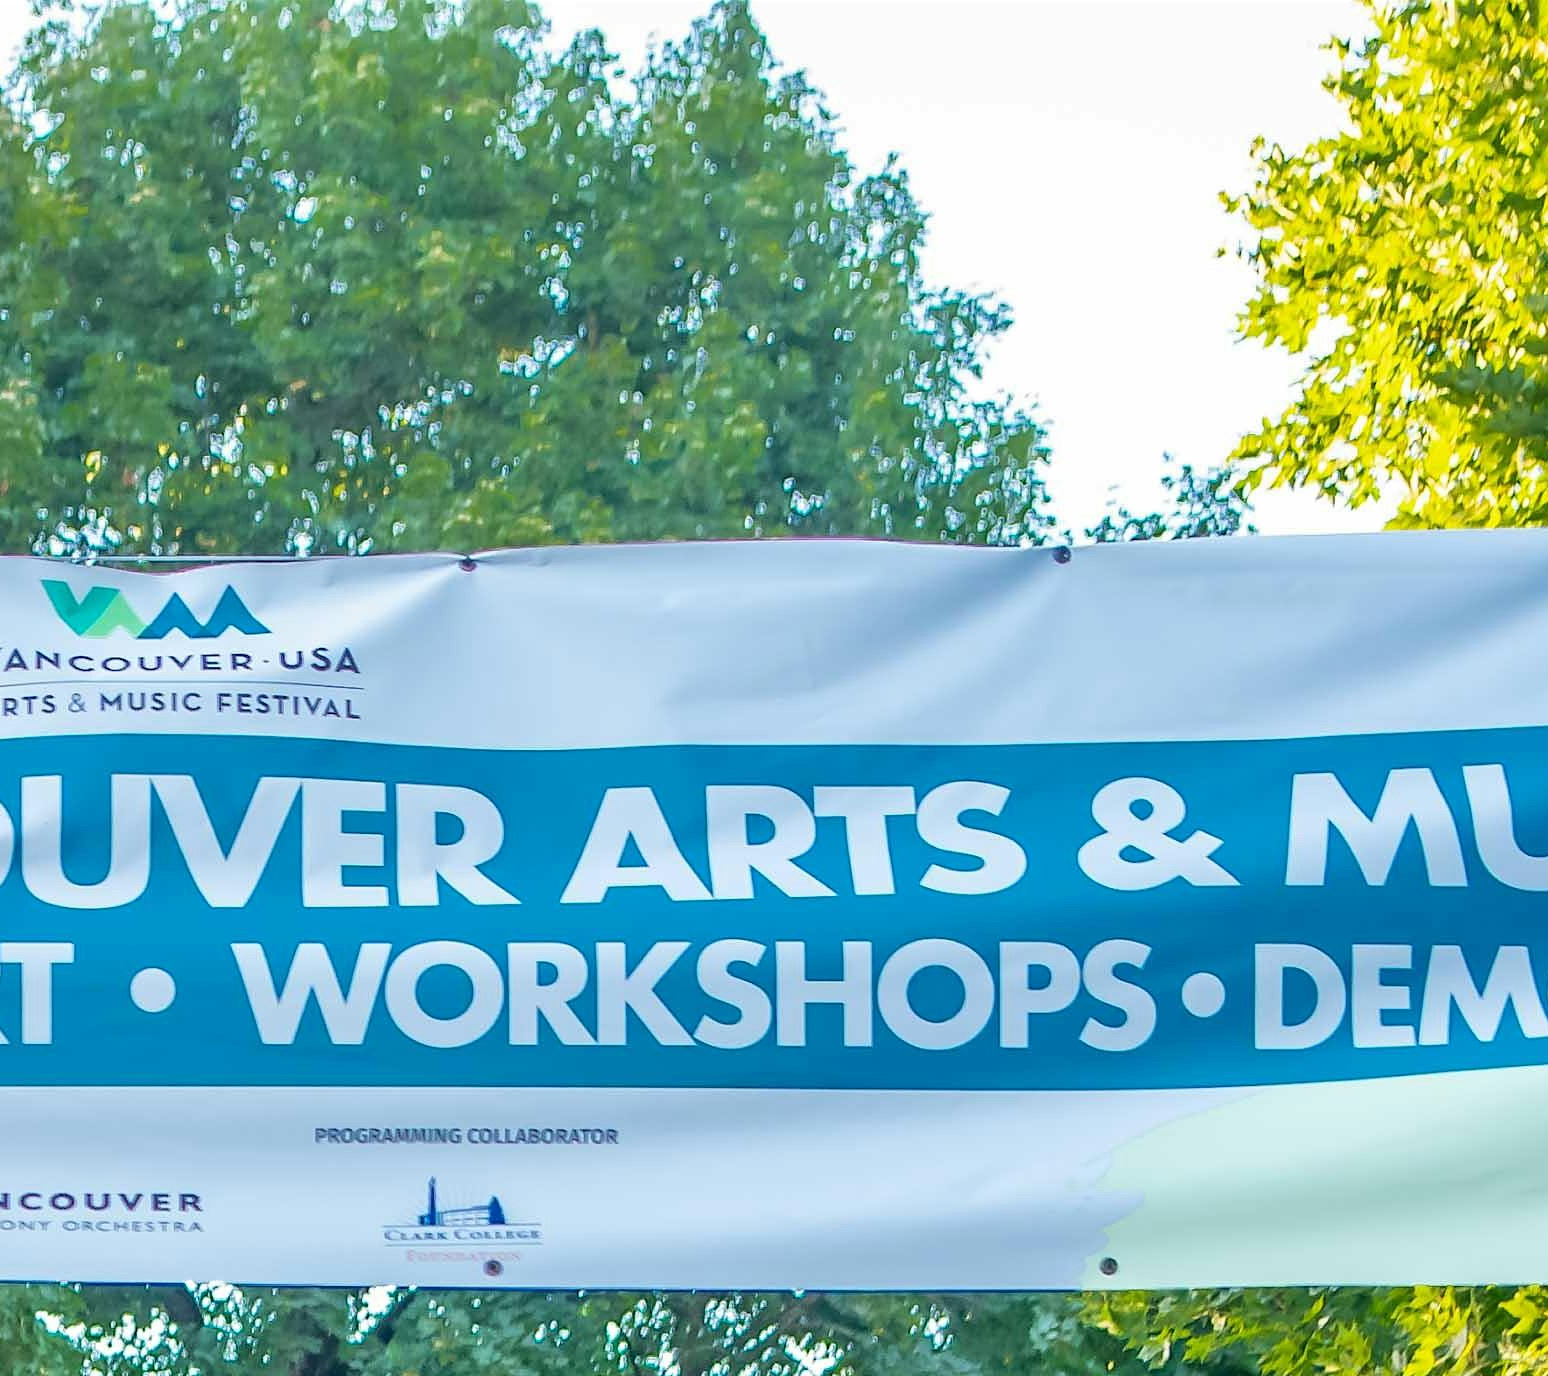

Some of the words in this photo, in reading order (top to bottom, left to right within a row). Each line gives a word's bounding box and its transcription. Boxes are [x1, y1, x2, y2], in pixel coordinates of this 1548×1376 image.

[279, 647, 361, 674] USA
[68, 693, 86, 713] &
[100, 692, 203, 712] MUSIC
[217, 693, 362, 720] FESTIVAL
[560, 782, 1028, 904] ARTS
[1078, 777, 1239, 892] &
[230, 938, 1156, 1051] WORKSHOPS
[314, 1127, 462, 1145] PROGRAMMING
[467, 1127, 619, 1145] COLLABORATOR
[62, 1219, 204, 1233] ORCHESTRA
[383, 1229, 448, 1241] CLARK
[453, 1228, 543, 1241] COLLEGE
